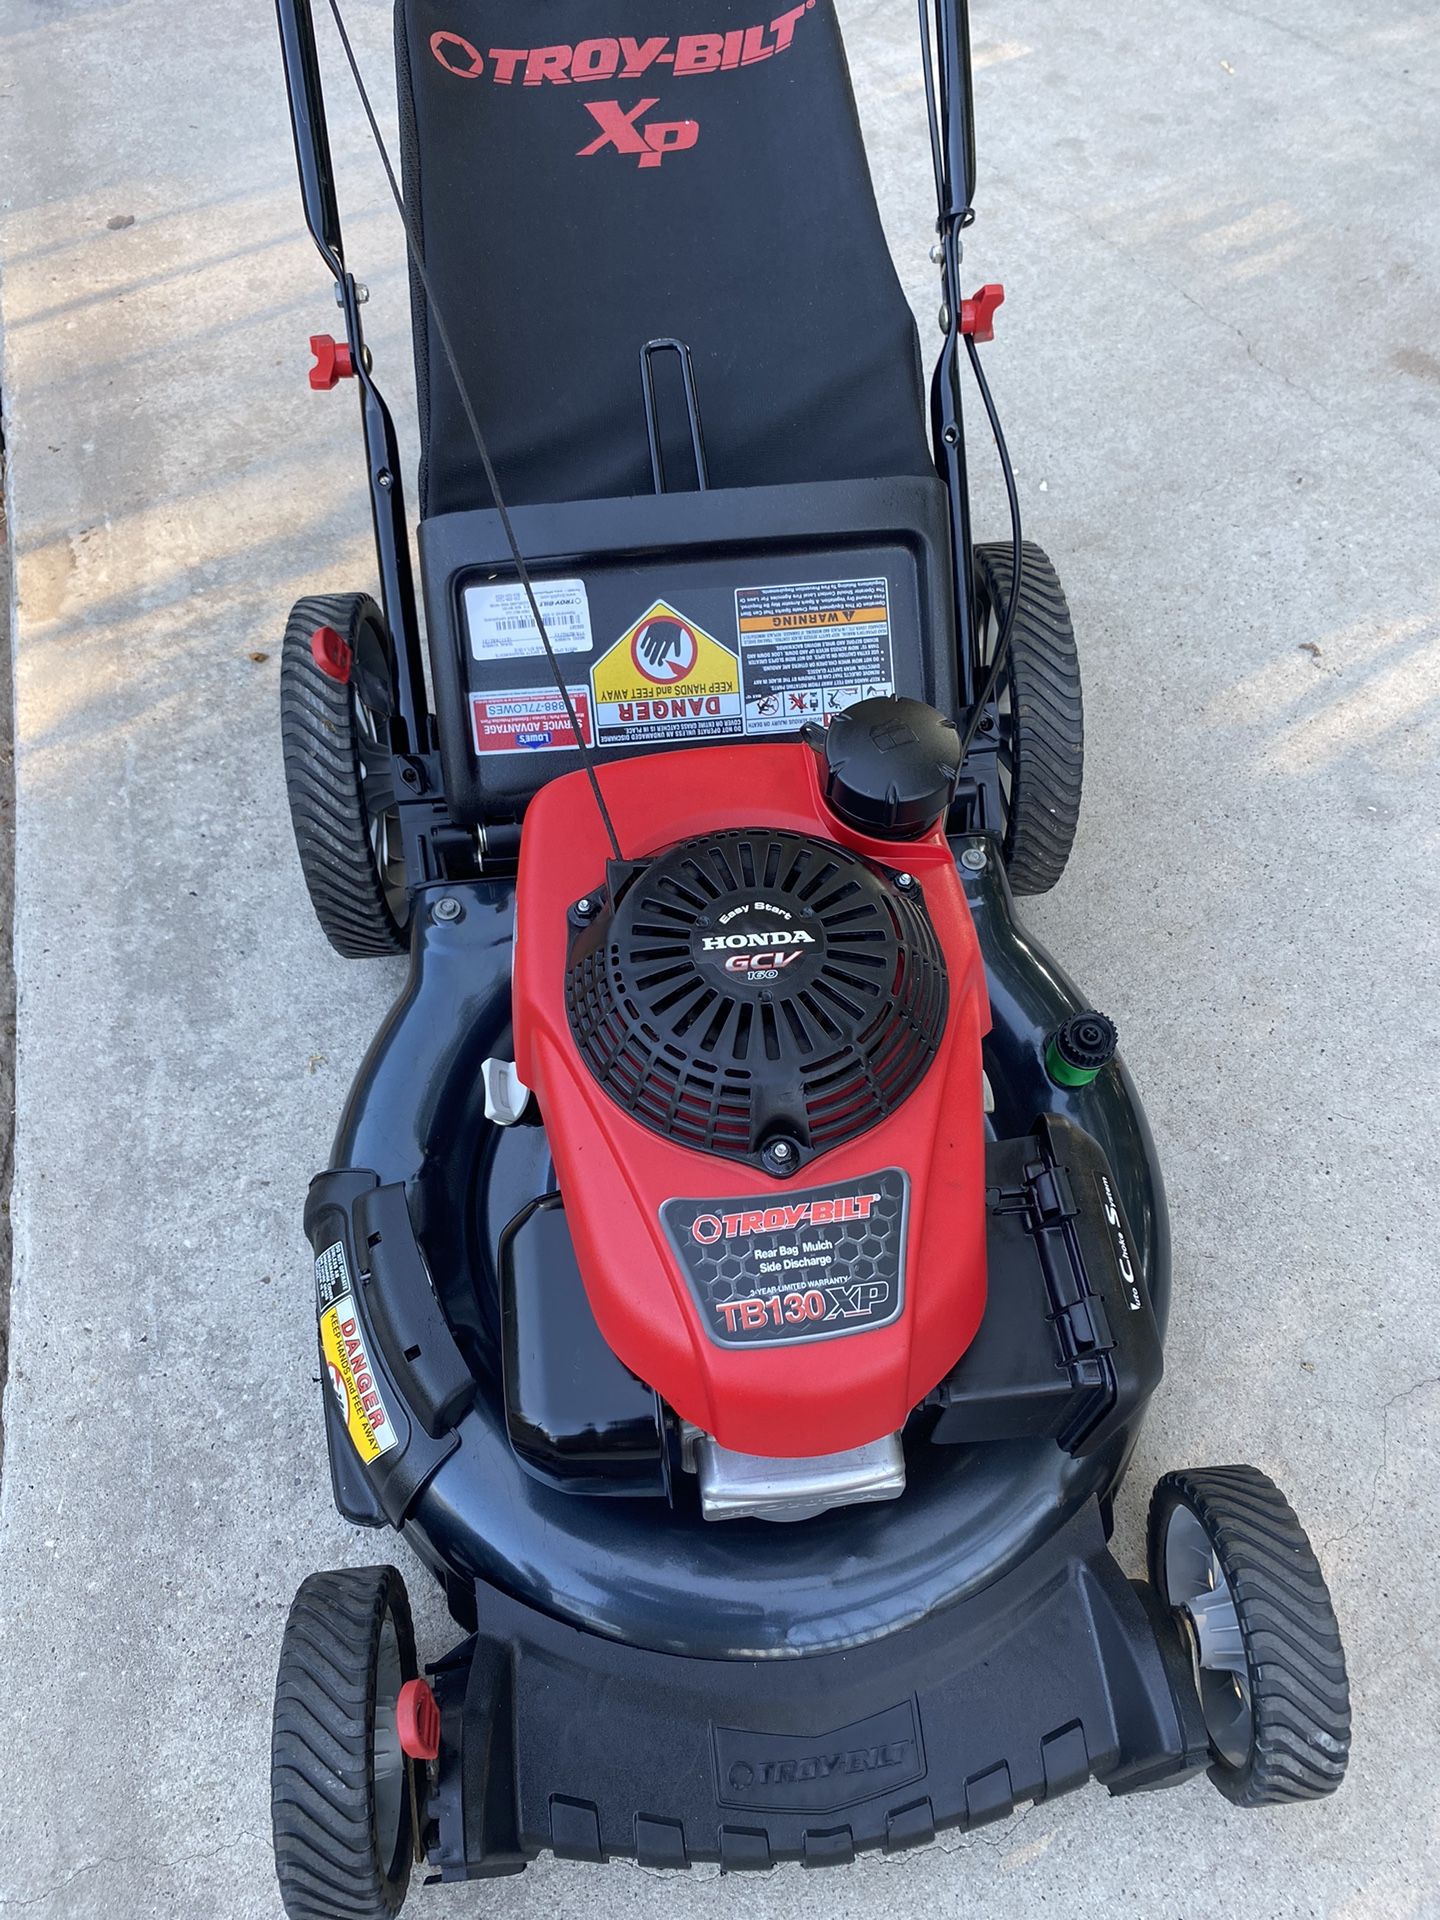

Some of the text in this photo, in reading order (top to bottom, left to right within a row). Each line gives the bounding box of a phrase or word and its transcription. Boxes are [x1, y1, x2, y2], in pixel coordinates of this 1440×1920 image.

[488, 4, 805, 86] TROY-BILT
[771, 612, 838, 627] WARNING
[600, 681, 732, 701] KEEP HANDS and FEET AWAY
[488, 700, 566, 715] 888-77LOWES
[617, 696, 720, 722] DANGER
[483, 718, 582, 734] SRVICE ADVANTAGE
[630, 731, 665, 740] UNDAMAGED
[674, 728, 695, 737] UNLESS
[696, 726, 721, 735] OPERATE
[600, 733, 629, 742] DISCHARGE
[719, 902, 792, 925] Easy Start
[702, 930, 815, 951] HONDA
[725, 950, 803, 972] GCV
[747, 969, 778, 980] 160
[1102, 1176, 1121, 1228] System
[722, 1193, 876, 1237] TROY-BILT
[754, 1240, 833, 1260] Rear Bag Mulch
[1119, 1232, 1134, 1284] Choke
[760, 1255, 832, 1273] Side Discharge
[807, 1276, 849, 1289] WARRANTY
[330, 1314, 379, 1451] KEEP HANDS and FEET AWAY
[341, 1318, 385, 1430] DANGER
